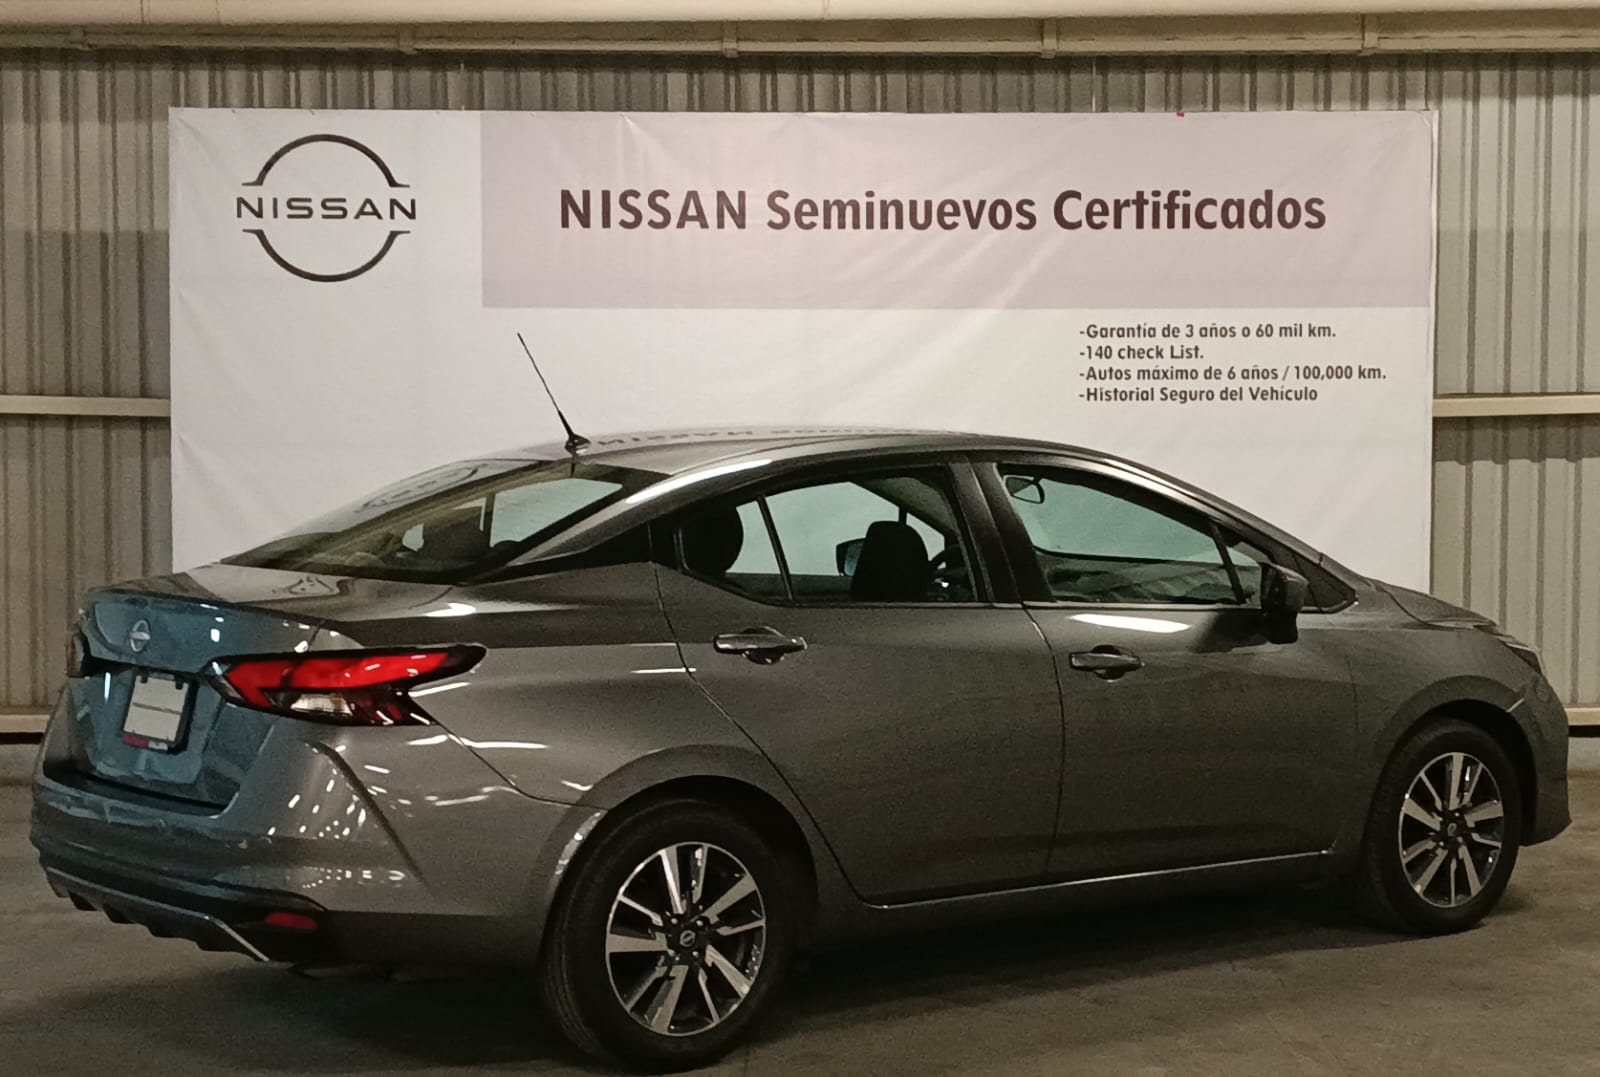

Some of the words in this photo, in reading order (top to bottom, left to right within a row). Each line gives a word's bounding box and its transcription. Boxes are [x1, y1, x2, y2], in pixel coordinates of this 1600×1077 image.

[236, 196, 417, 221] NISSAN
[560, 188, 747, 230] NISSAN
[767, 189, 1038, 231] Seminuevos
[1054, 188, 1327, 231] Certificados
[1079, 322, 1157, 339] -Garantía
[1161, 323, 1181, 339] de
[1185, 323, 1195, 339] 3
[1198, 322, 1237, 339] años
[1241, 325, 1251, 339] o
[1255, 323, 1274, 339] 60
[1278, 322, 1303, 338] mil
[1307, 322, 1337, 338] km.
[1079, 344, 1113, 360] -140
[1117, 344, 1165, 360] check
[1169, 344, 1204, 360] List.
[1079, 365, 1132, 381] -Autos
[1136, 364, 1199, 381] máximo
[1203, 365, 1223, 381] de
[1226, 365, 1237, 381] 6
[1240, 364, 1279, 381] años
[1281, 365, 1291, 382] /
[1293, 364, 1354, 381] 100,000
[1357, 364, 1387, 380] km.
[1079, 386, 1155, 403] -Historial
[1159, 386, 1215, 405] Seguro
[1219, 386, 1244, 402] del
[1248, 385, 1319, 402] Vehículo
